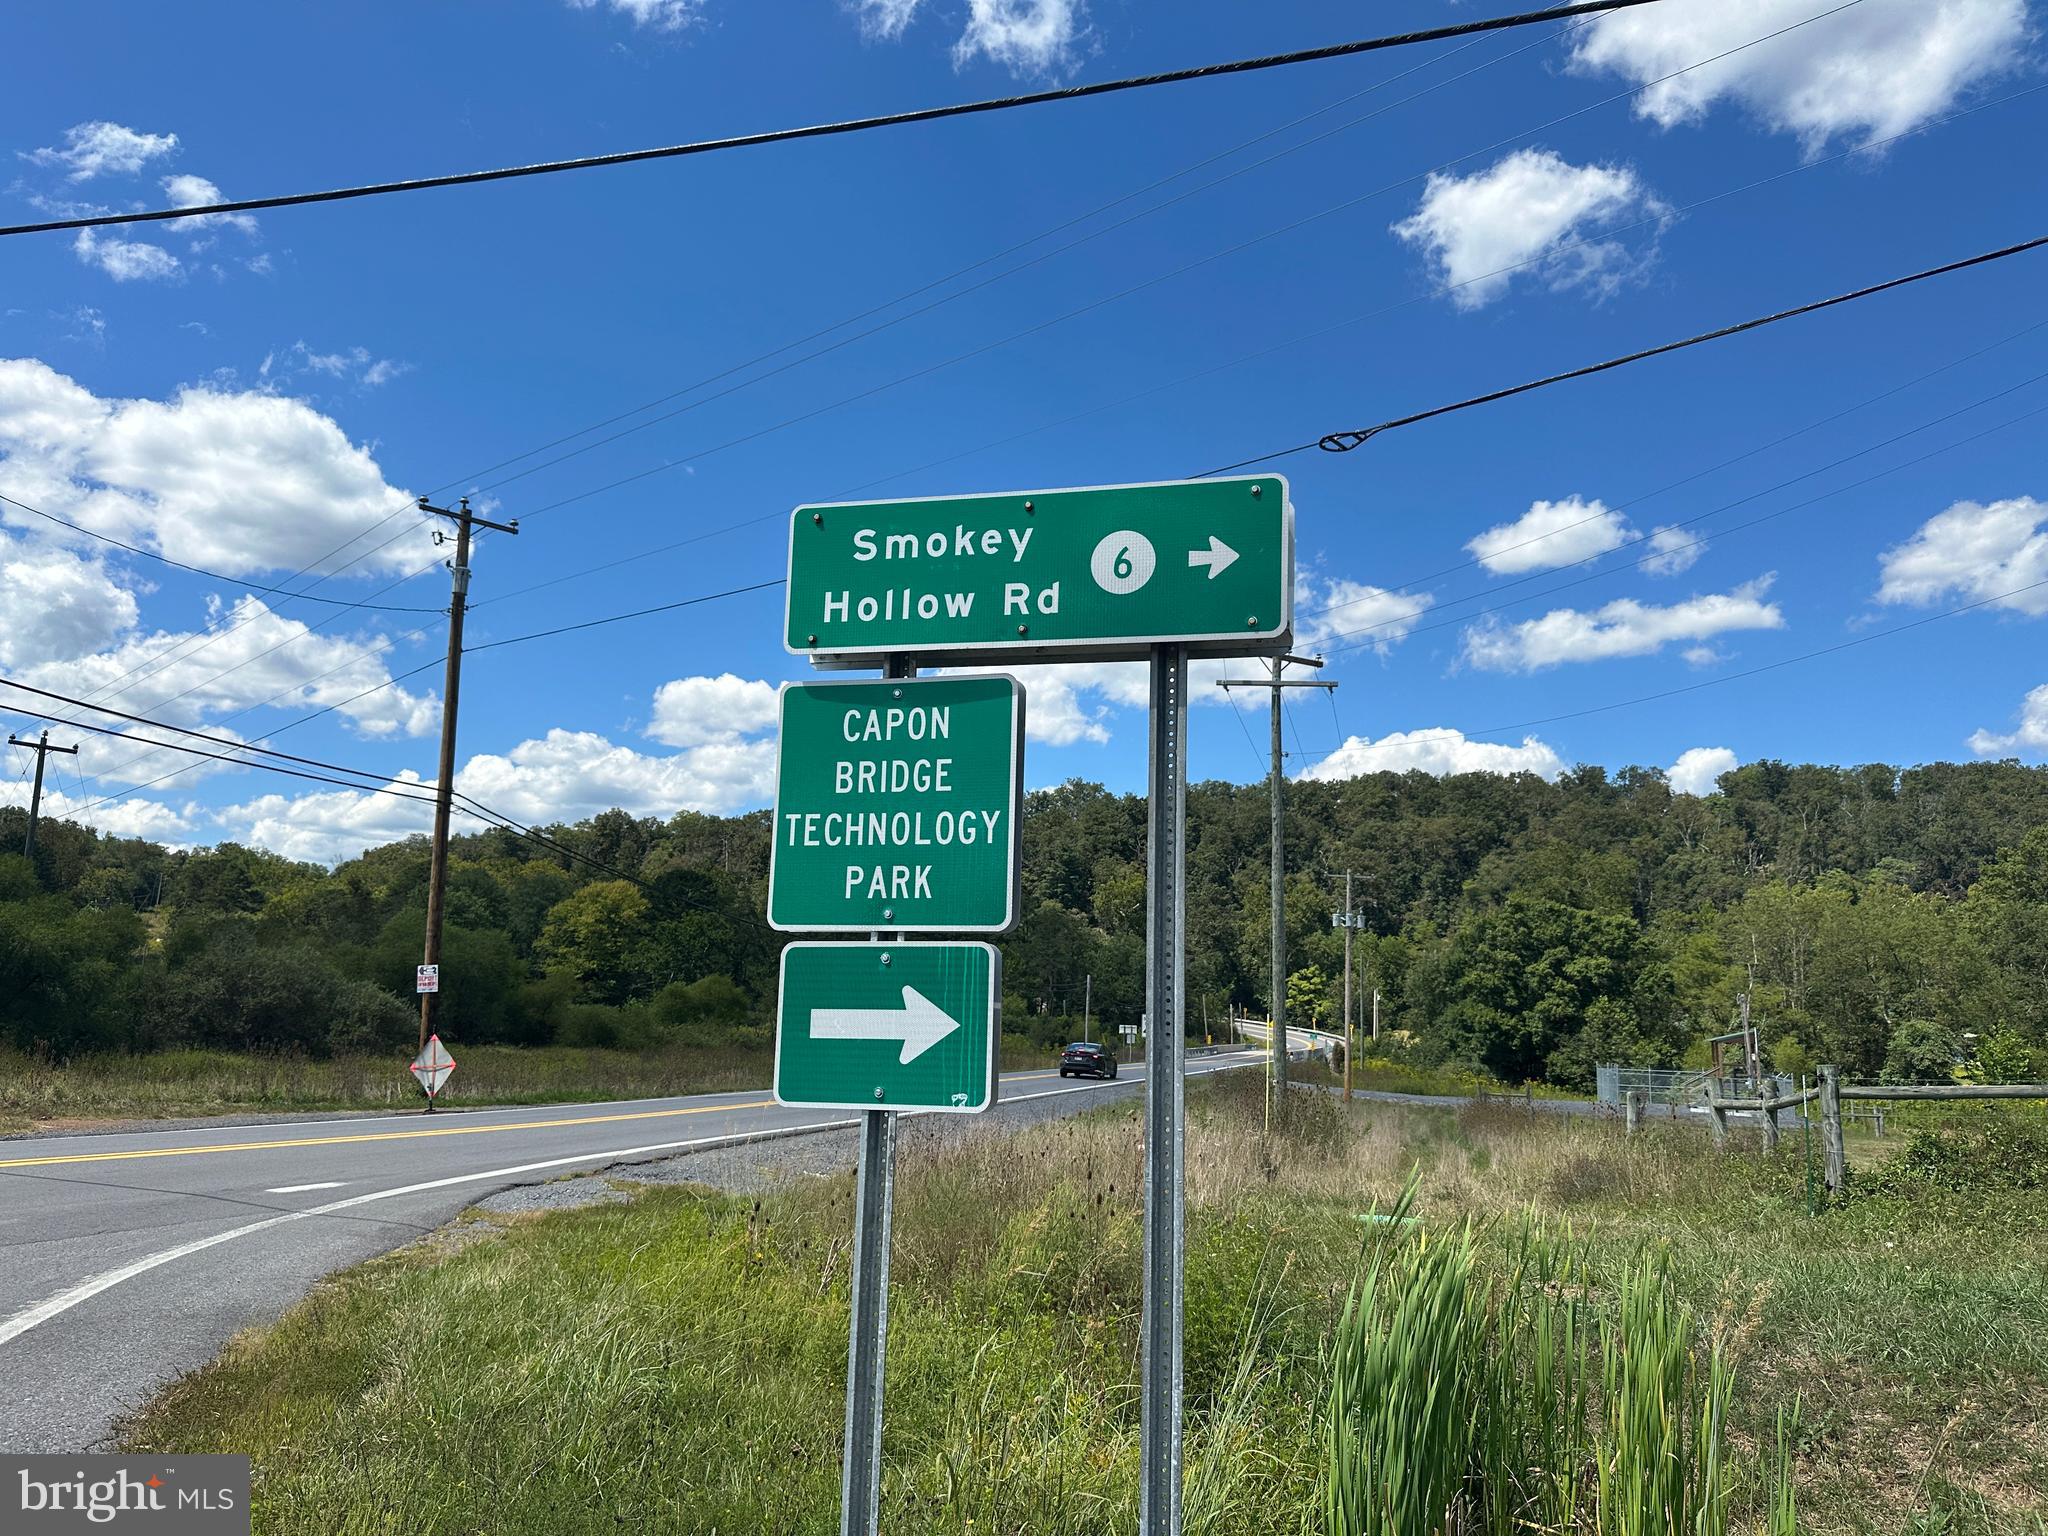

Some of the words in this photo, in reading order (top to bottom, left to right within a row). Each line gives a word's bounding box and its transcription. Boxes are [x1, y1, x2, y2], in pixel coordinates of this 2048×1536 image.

[854, 525, 1034, 563] Smokey
[1113, 546, 1133, 579] 6
[824, 589, 975, 622] Hollow
[1003, 582, 1060, 616] Rd
[843, 706, 950, 742] CAPON
[835, 758, 953, 794] BRIDGE
[785, 810, 1001, 847] TECHNOLOGY
[845, 865, 933, 899] PARK
